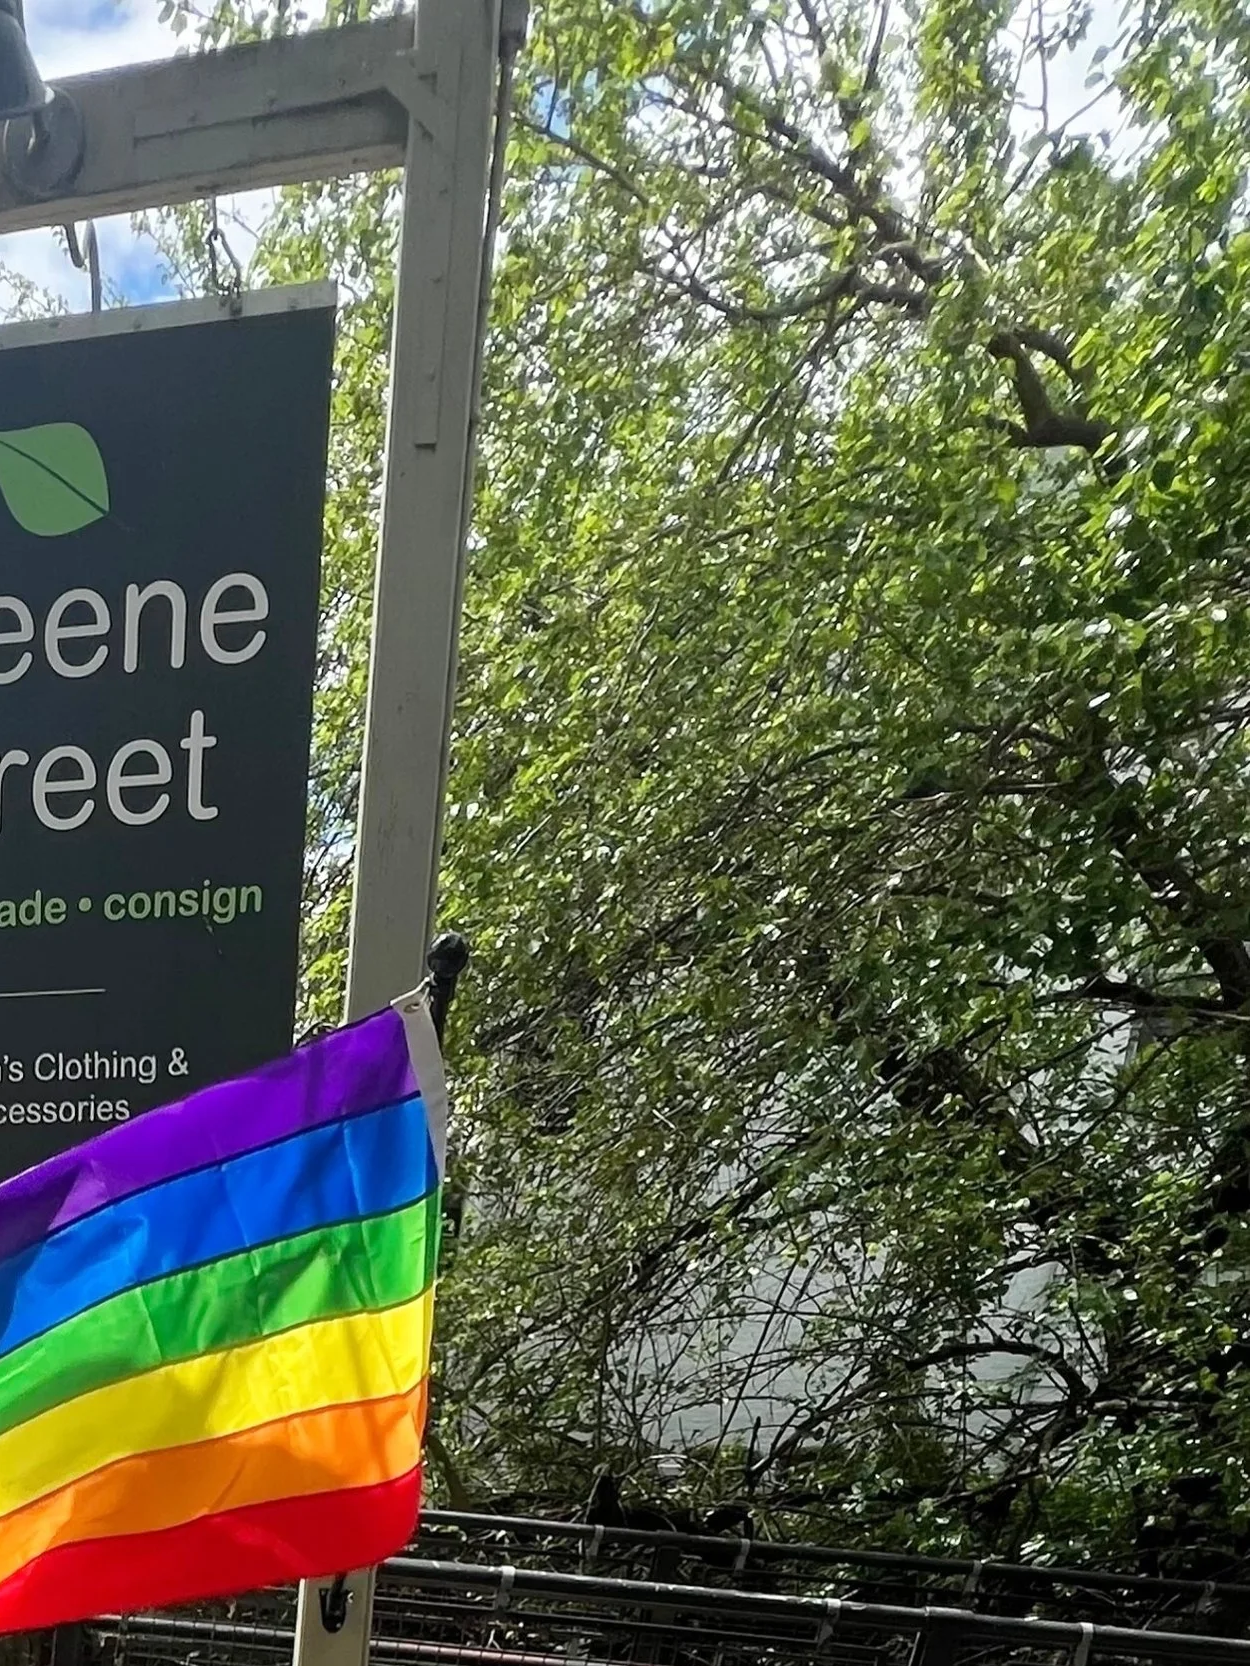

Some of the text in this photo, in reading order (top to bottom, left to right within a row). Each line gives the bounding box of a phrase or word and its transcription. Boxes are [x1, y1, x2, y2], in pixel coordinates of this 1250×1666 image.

[103, 879, 263, 925] consign
[34, 1049, 158, 1084] Clothing
[167, 1047, 190, 1077] &
